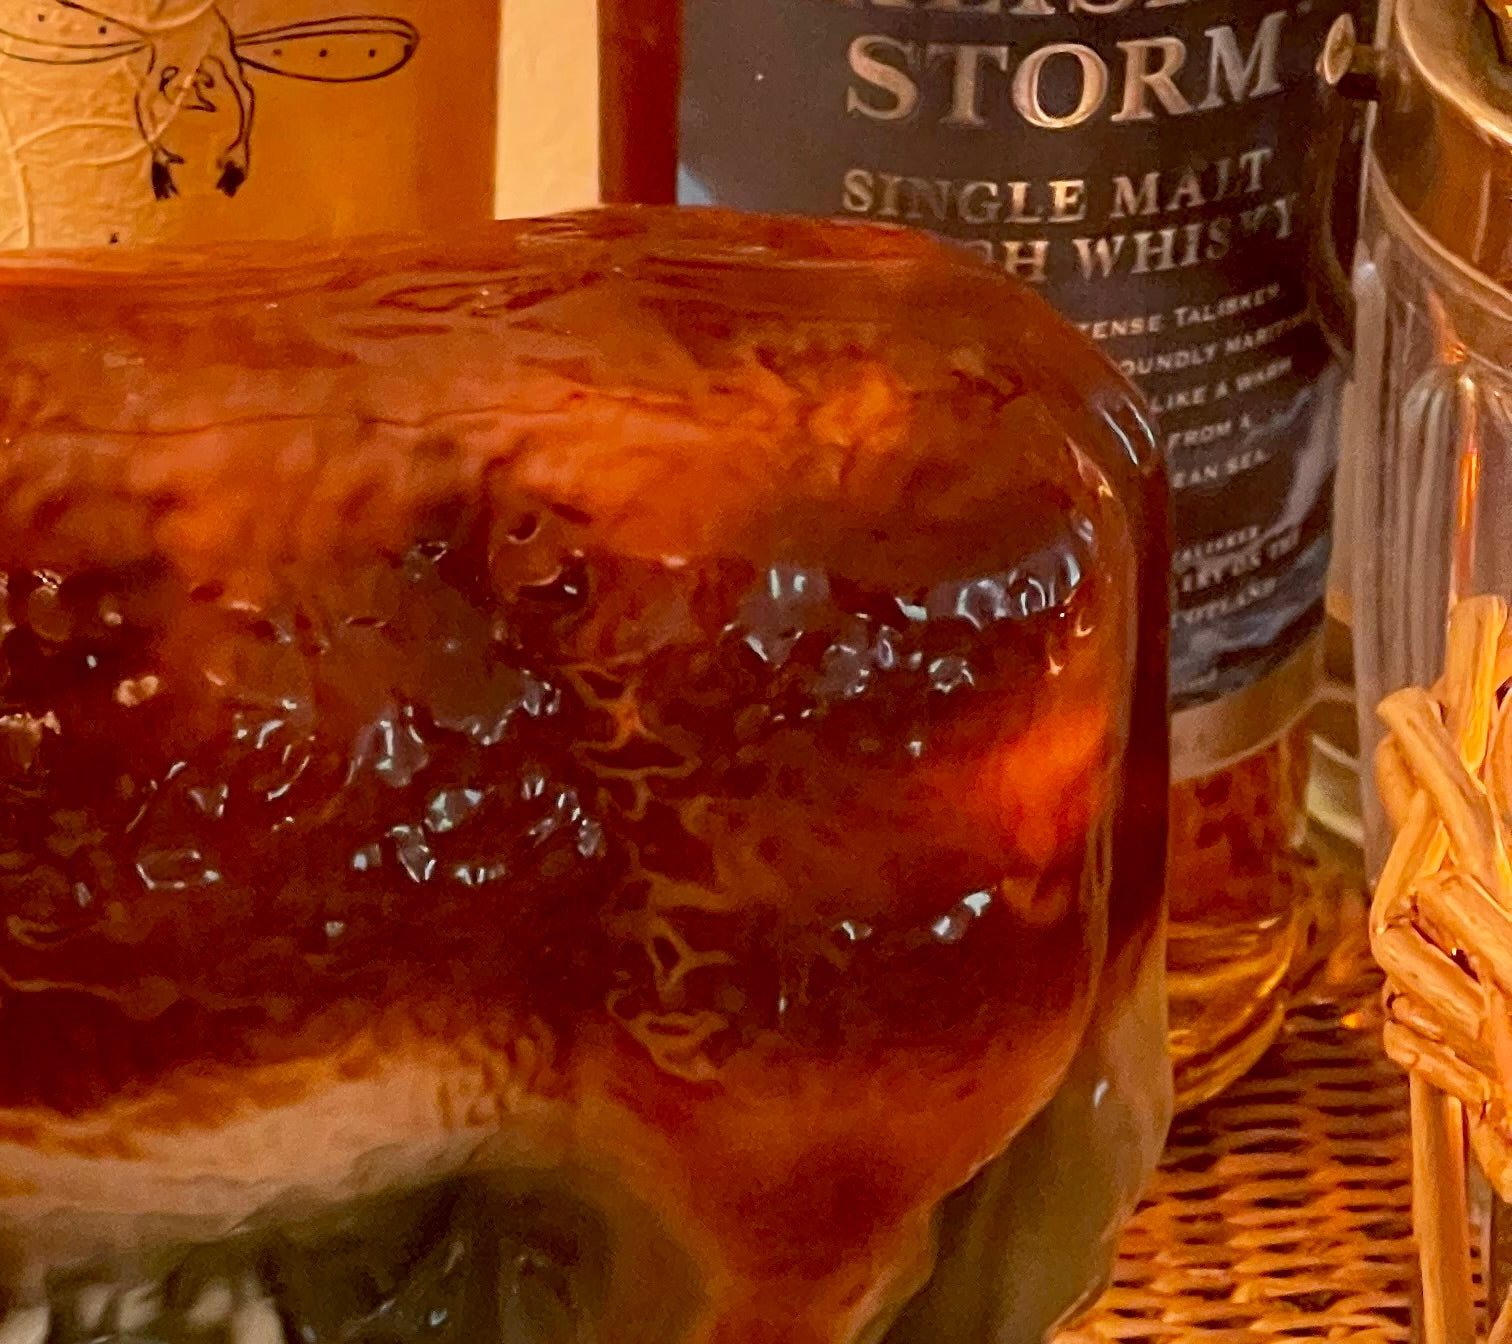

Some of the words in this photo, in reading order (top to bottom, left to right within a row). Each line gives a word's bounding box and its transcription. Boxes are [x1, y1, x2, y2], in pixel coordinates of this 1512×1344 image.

[845, 10, 1290, 131] STORM
[840, 167, 1088, 226] SINGLE
[1110, 148, 1274, 221] MALT
